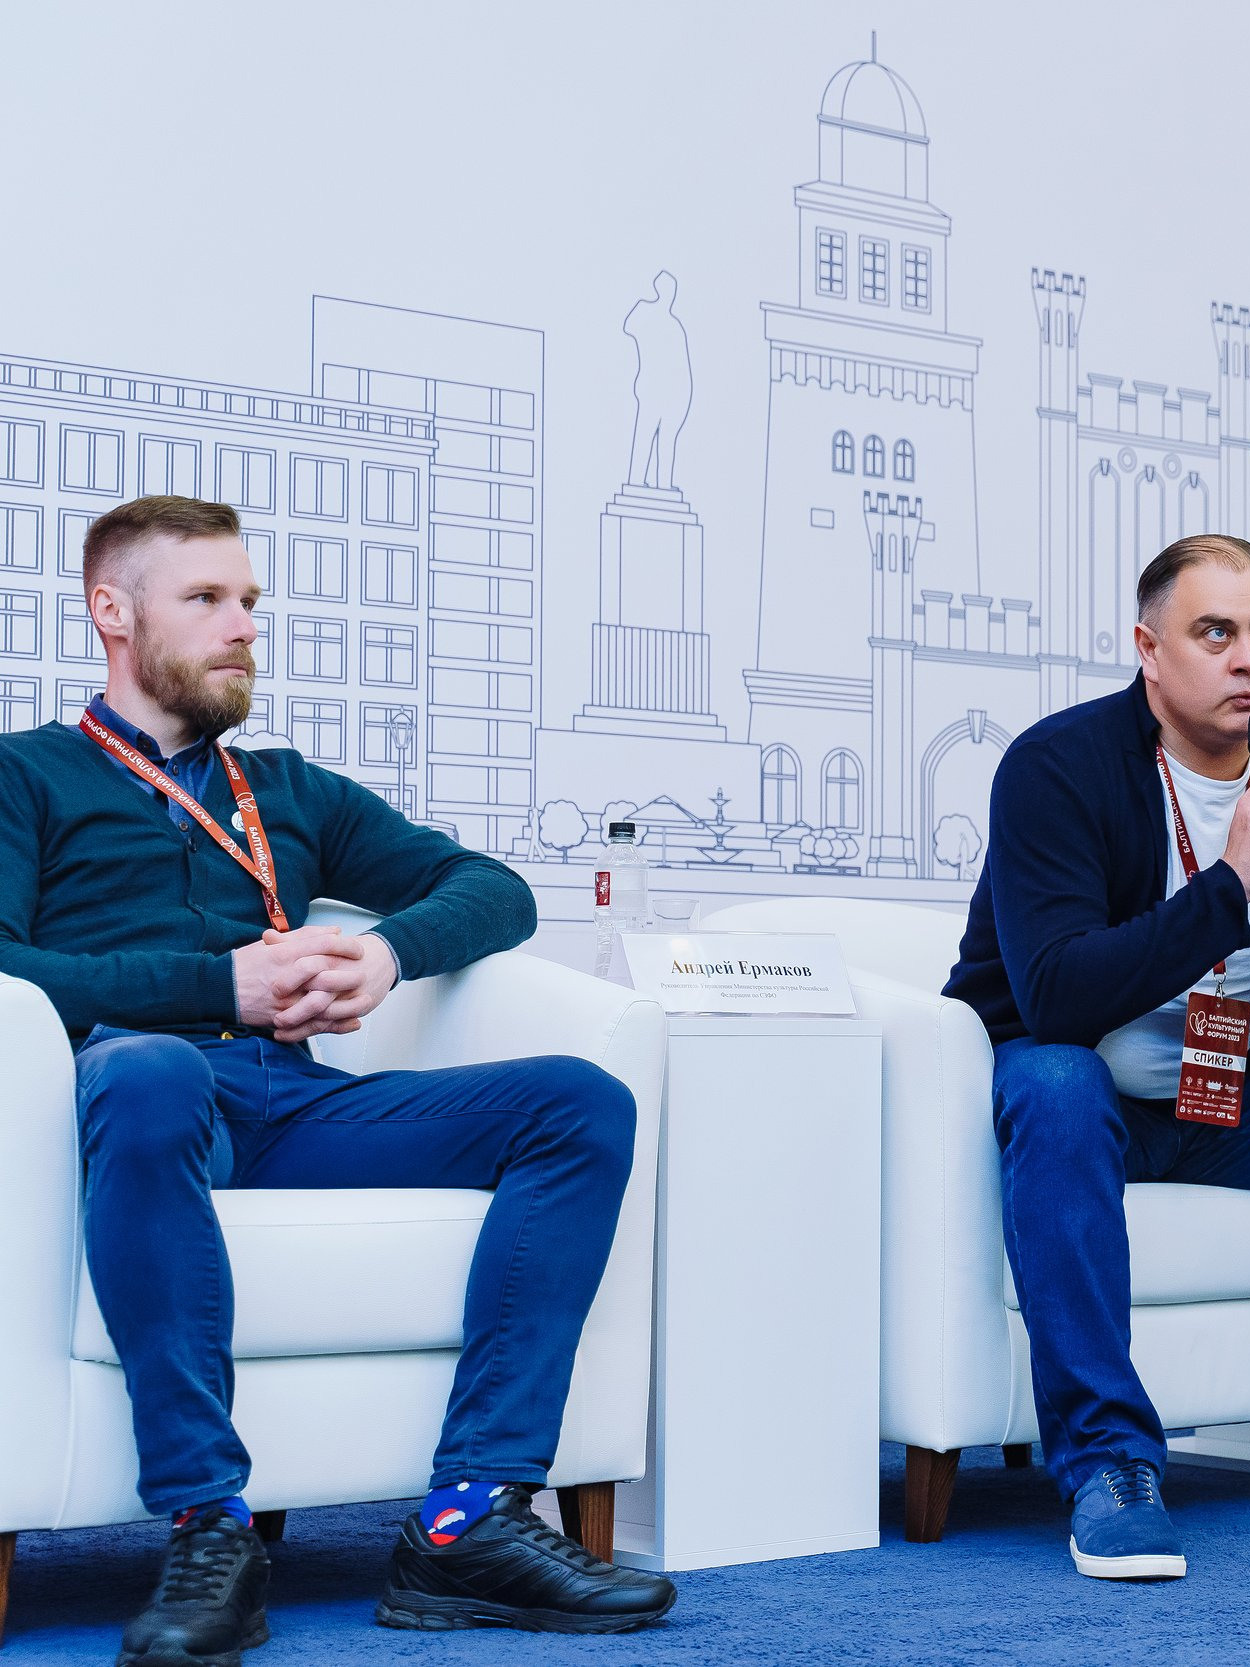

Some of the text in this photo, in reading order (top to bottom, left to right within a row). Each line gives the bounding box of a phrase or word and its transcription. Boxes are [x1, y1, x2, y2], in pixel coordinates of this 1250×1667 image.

[106, 736, 158, 779] КУЛЬТУРНЫЙ
[155, 776, 212, 825] БАЛТИЙСКИЙ
[671, 959, 812, 979] Андрей Ермаков
[1208, 1014, 1248, 1027] БАЛТИЙСКИЙ
[1207, 1023, 1245, 1035] КУЛЬТУРНЫЙ
[1207, 1031, 1240, 1042] ФОРУМ 2023
[1193, 1052, 1234, 1067] СПИКЕР
